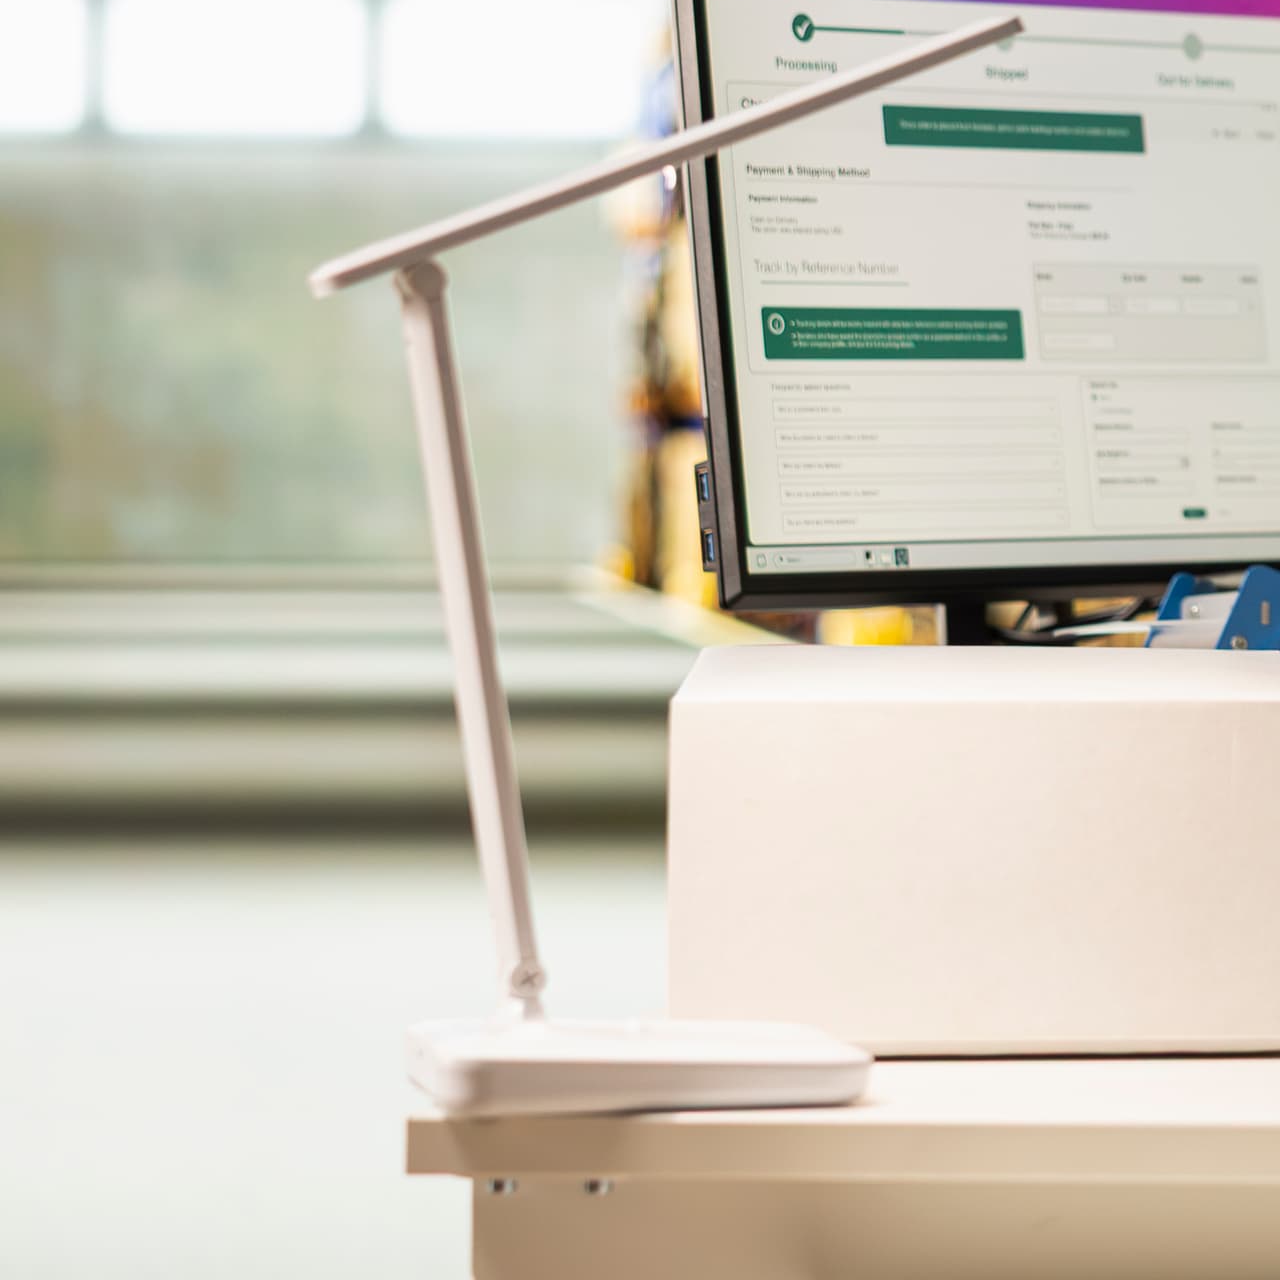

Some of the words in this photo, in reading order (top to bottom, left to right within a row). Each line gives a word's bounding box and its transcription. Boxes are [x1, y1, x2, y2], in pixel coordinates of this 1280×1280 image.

[775, 56, 838, 74] Processing
[746, 163, 786, 178] Payment
[796, 165, 836, 180] Shipping
[838, 167, 871, 178] Method
[753, 259, 783, 274] Track
[785, 260, 799, 276] by
[801, 260, 857, 274] Reference
[858, 261, 901, 275] Number
